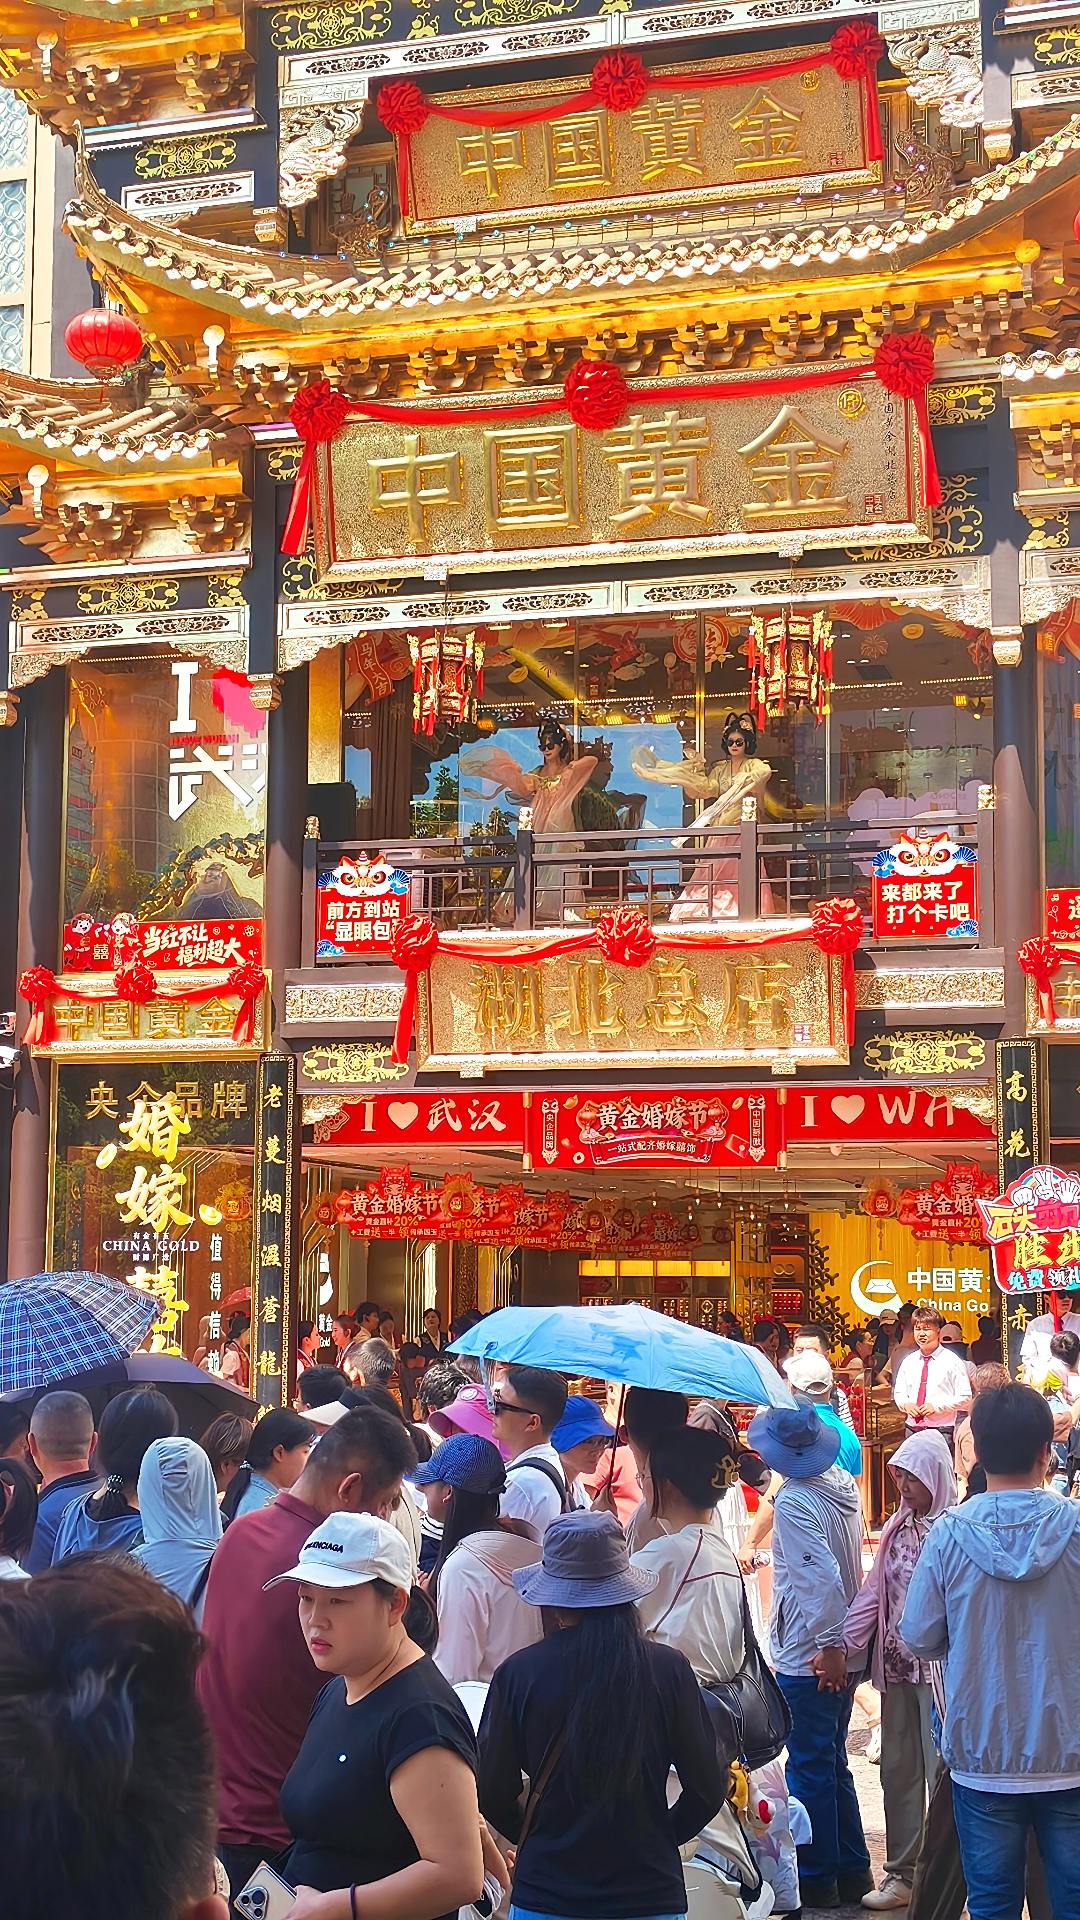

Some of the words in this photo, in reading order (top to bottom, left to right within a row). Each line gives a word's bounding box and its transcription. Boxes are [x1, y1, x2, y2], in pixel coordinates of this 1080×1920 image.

[456, 84, 805, 198] 中国黄金
[365, 404, 851, 545] 中国黄金
[169, 661, 198, 734] I
[881, 881, 963, 902] 来都来了
[327, 899, 400, 920] 前方到站
[886, 903, 970, 924] 打个卡吧
[142, 923, 208, 958] 当红不让
[175, 937, 246, 967] 福利超大
[469, 953, 793, 1037] 湖北总店
[54, 997, 240, 1041] 中国黄金
[85, 1081, 248, 1120] 央企品牌
[360, 1101, 377, 1132] I
[426, 1097, 506, 1132] 武汉
[800, 1095, 819, 1127] I
[596, 1103, 708, 1132] 黄金婚嫁节
[350, 1193, 440, 1216] 黄金婚嫁节
[914, 1193, 992, 1216] 黄金婚
[102, 1240, 151, 1252] CHINA
[158, 1240, 200, 1252] GOLD
[907, 1266, 991, 1293] 中国黄
[966, 1298, 989, 1312] Go
